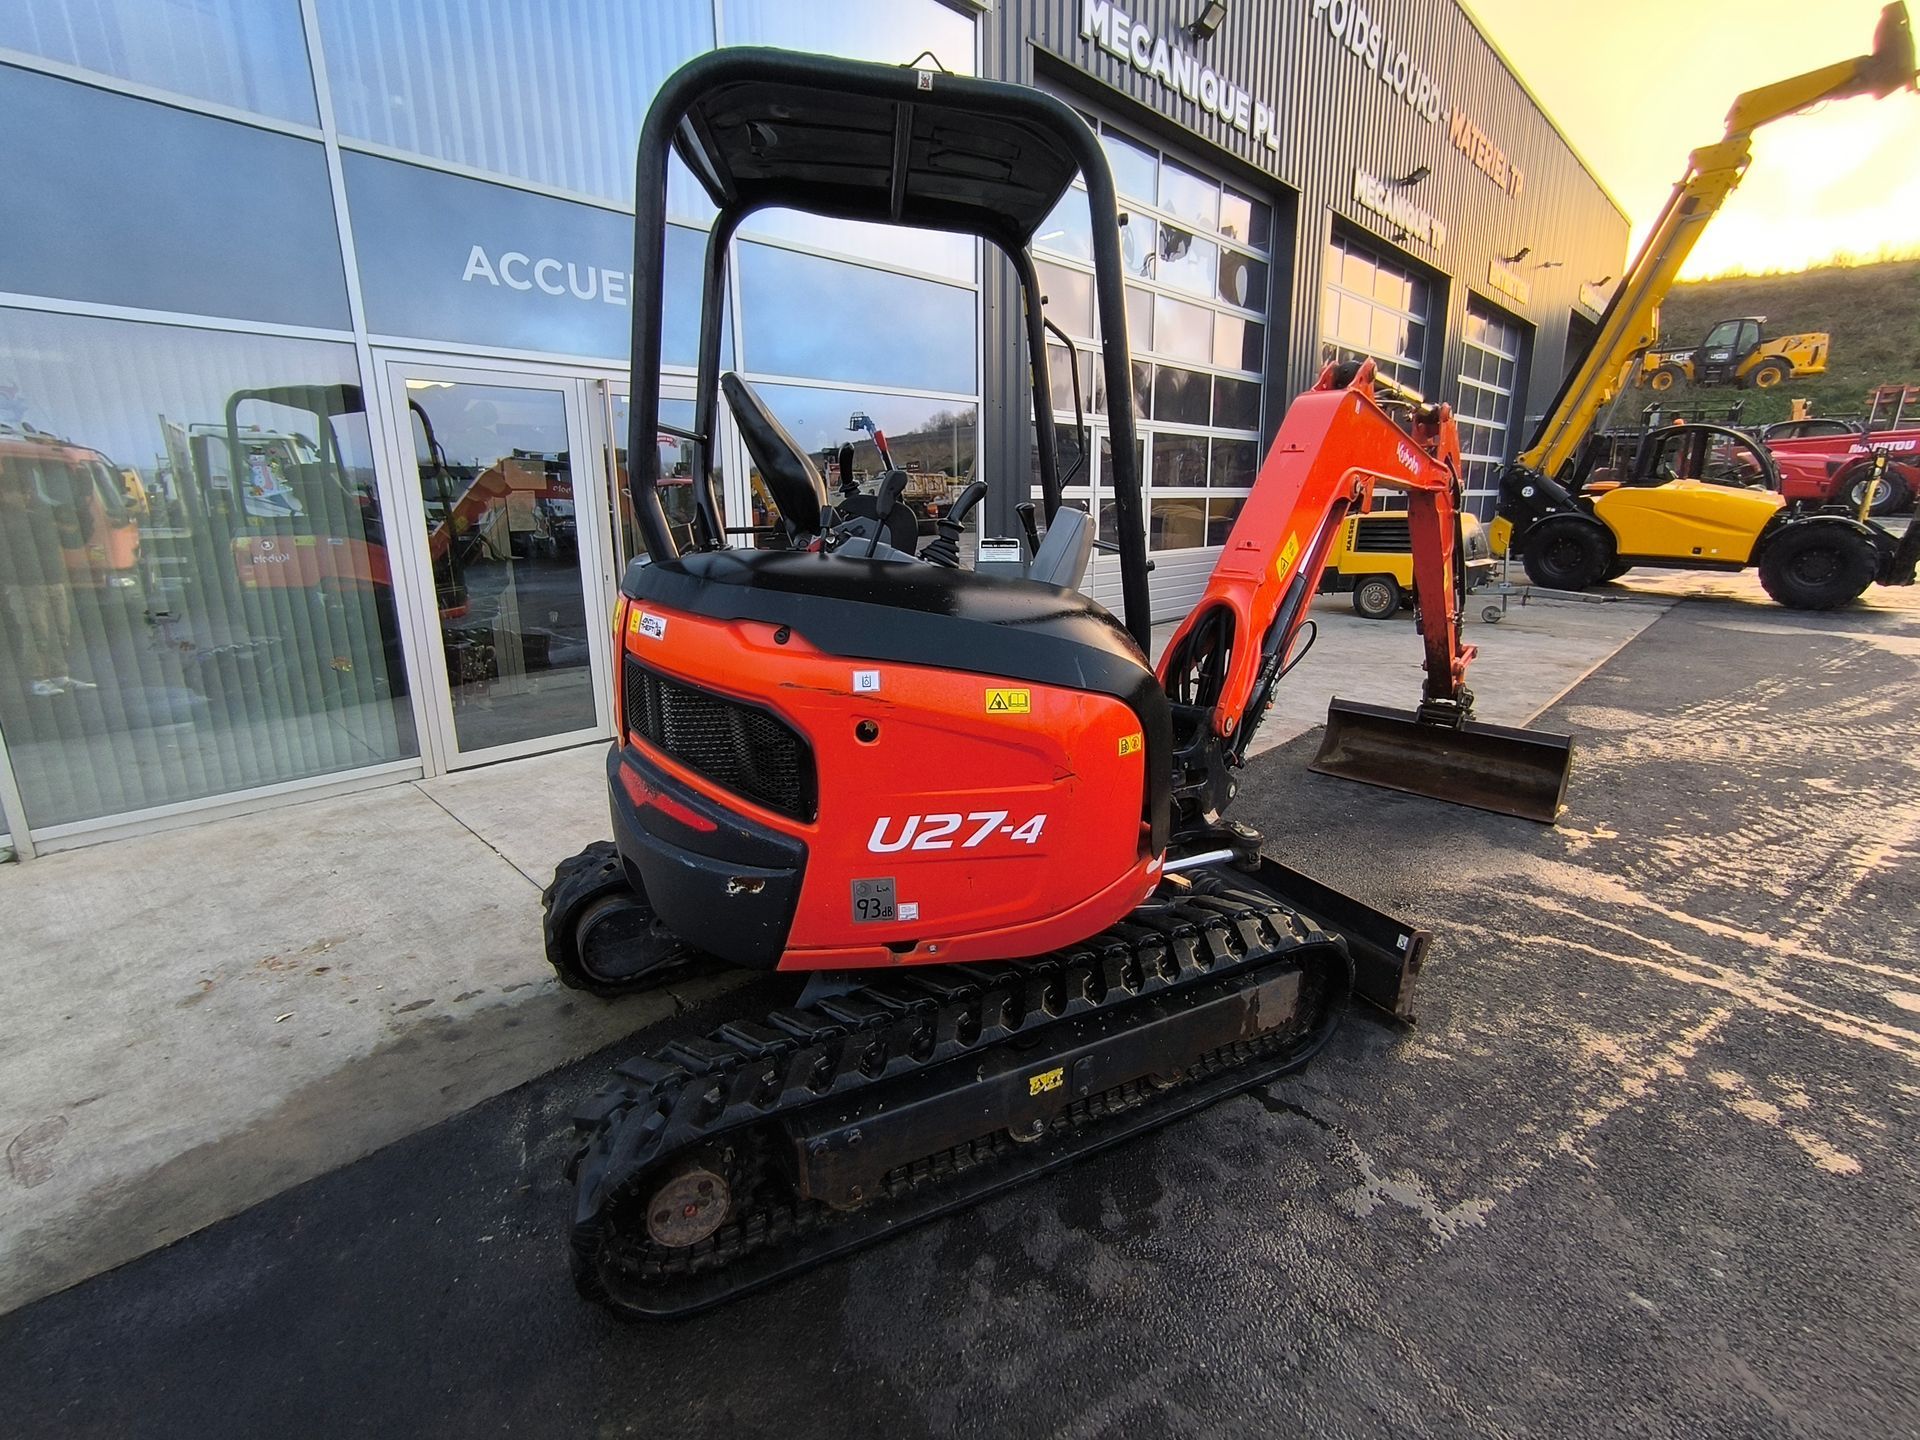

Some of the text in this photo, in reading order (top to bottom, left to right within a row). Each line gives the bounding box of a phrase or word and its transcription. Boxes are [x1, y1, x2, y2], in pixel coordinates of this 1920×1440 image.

[1080, 0, 1280, 151] MECANIQUE PL
[1382, 39, 1440, 123] LOURD
[1449, 104, 1506, 190] MATERIEL
[867, 811, 1047, 853] U27-4
